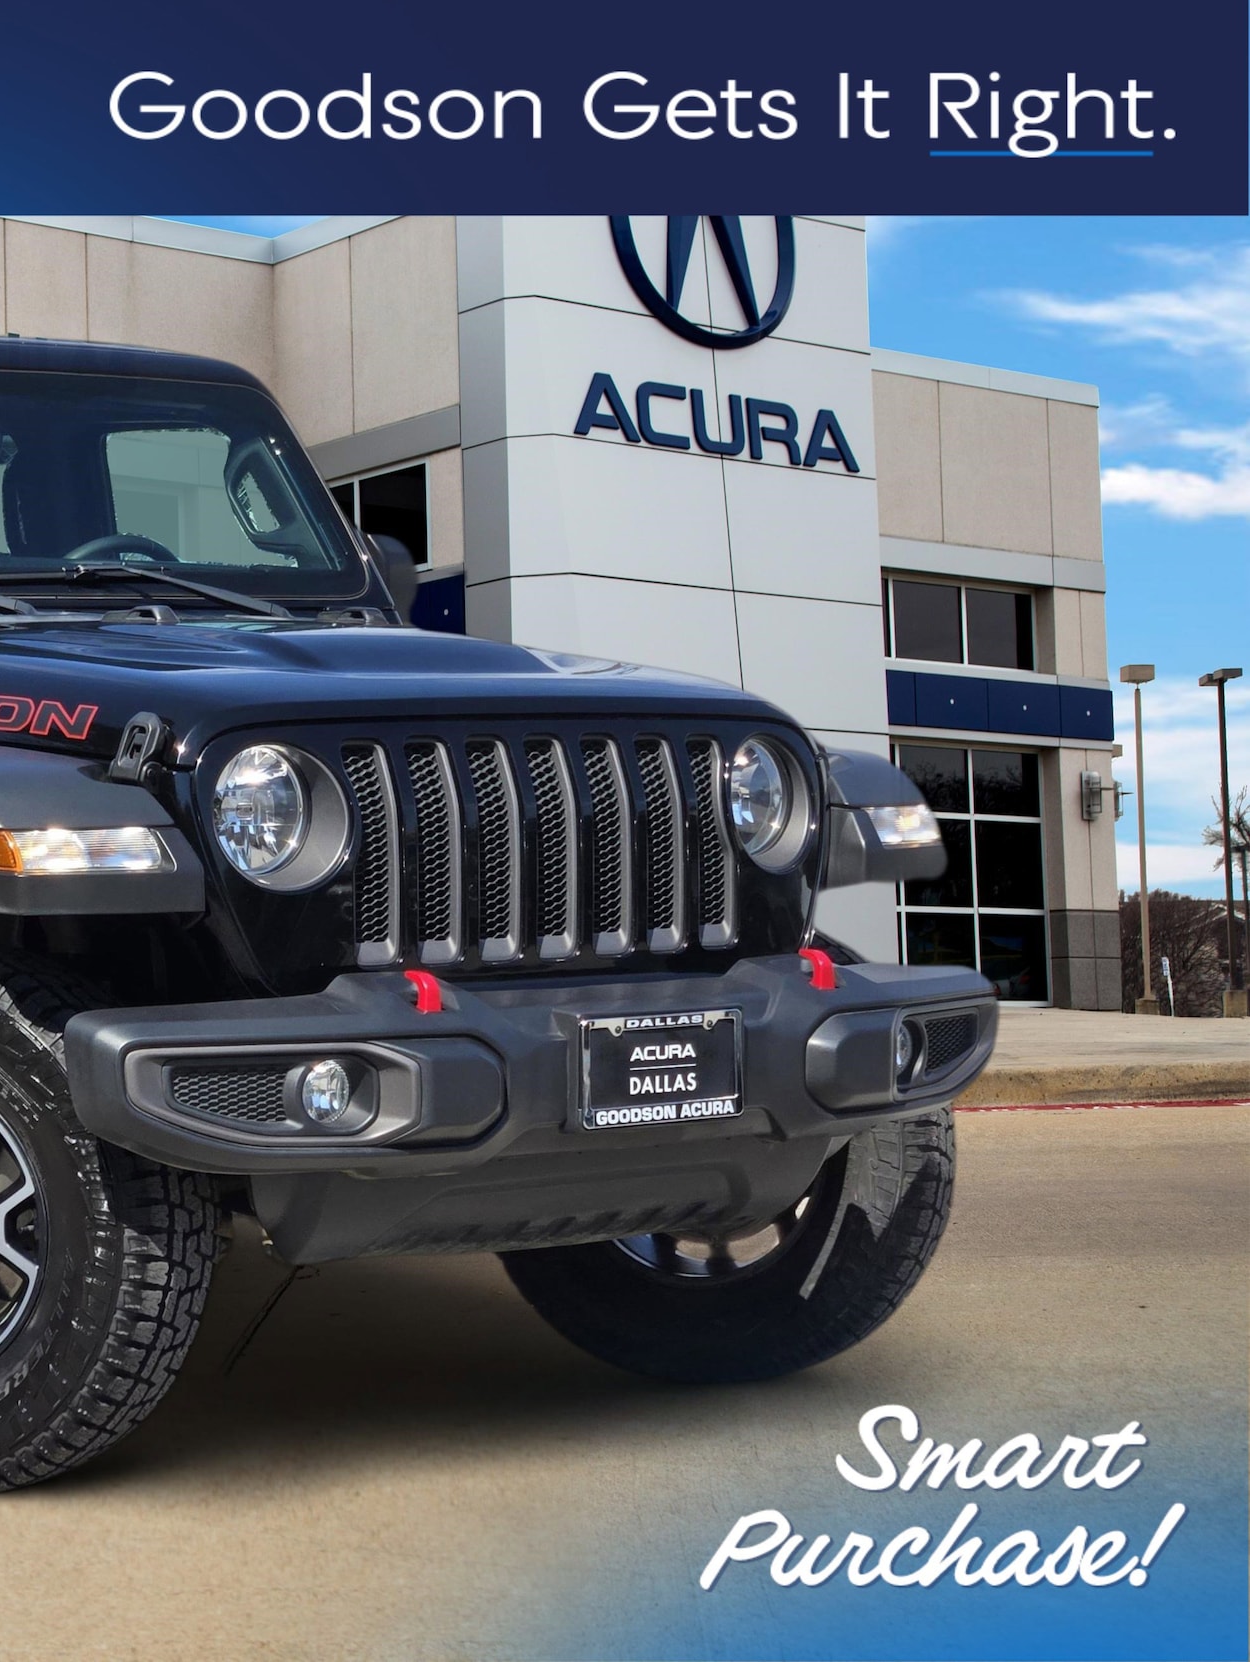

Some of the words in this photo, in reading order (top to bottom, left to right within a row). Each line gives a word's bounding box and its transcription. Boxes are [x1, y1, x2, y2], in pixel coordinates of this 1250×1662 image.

[573, 371, 860, 473] ACURA
[626, 1014, 704, 1029] DALLAS
[630, 1043, 697, 1062] ACURA
[629, 1072, 697, 1096] DALLAS
[596, 1104, 677, 1127] GOODSON
[680, 1099, 735, 1118] ACURA
